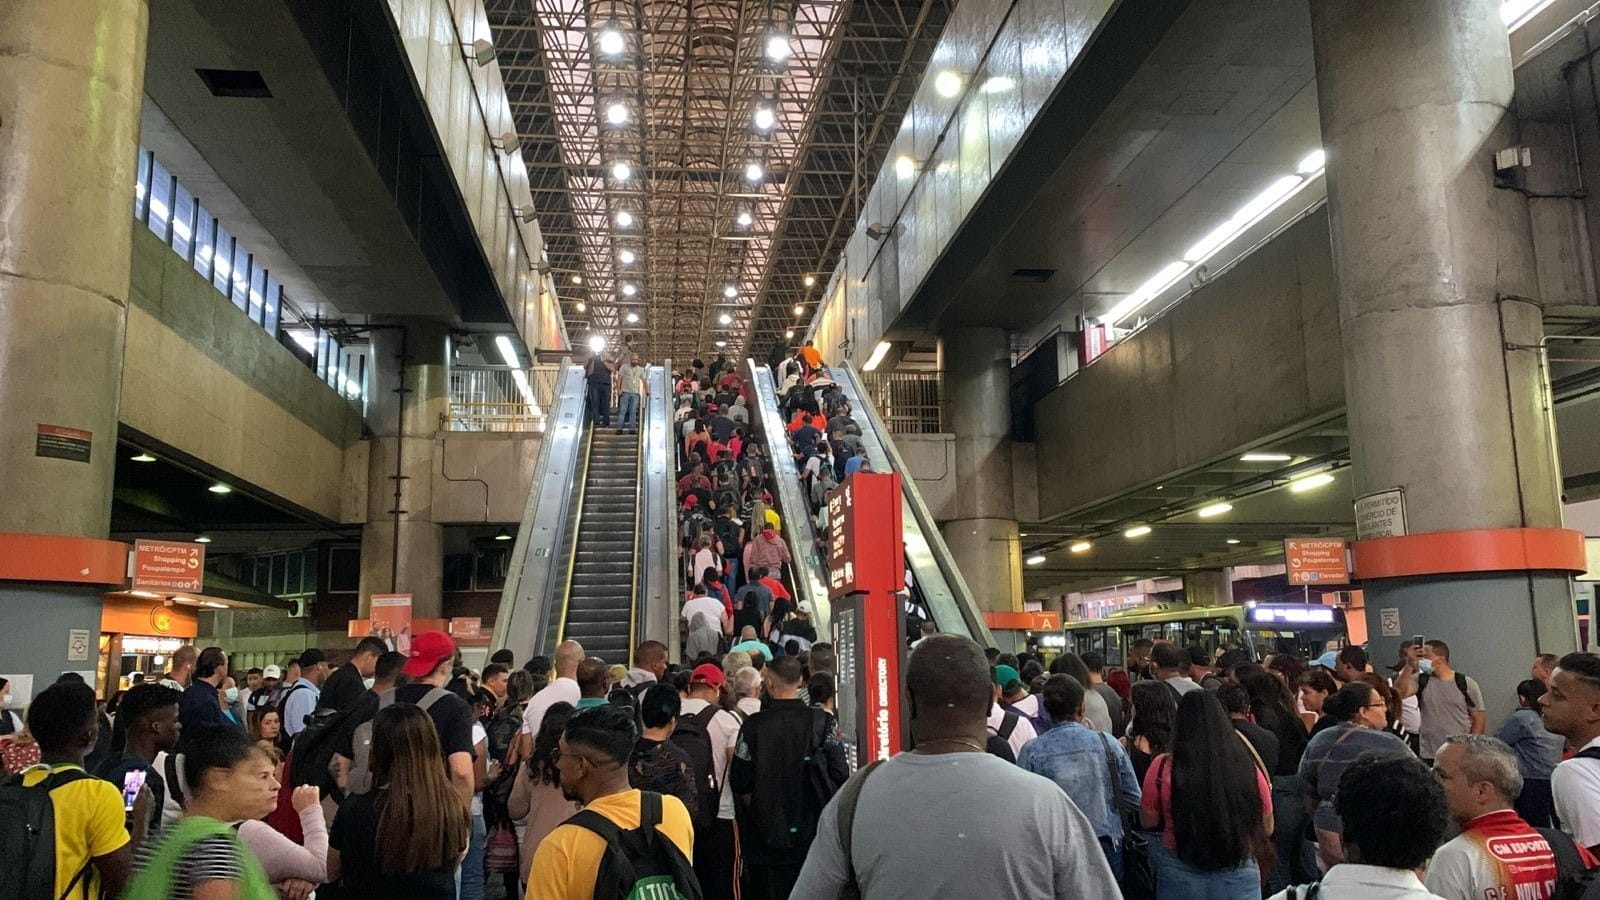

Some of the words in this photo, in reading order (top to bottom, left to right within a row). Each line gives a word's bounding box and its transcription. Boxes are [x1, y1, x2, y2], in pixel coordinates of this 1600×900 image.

[1386, 507, 1398, 517] DE
[138, 545, 187, 554] METRÔ/CPTM
[1302, 550, 1330, 558] Shopping
[153, 555, 187, 565] Shopping
[142, 564, 186, 574] Poupatempo
[136, 578, 171, 587] Sanitários
[1042, 618, 1053, 630] A
[878, 657, 888, 708] DIRECTORY
